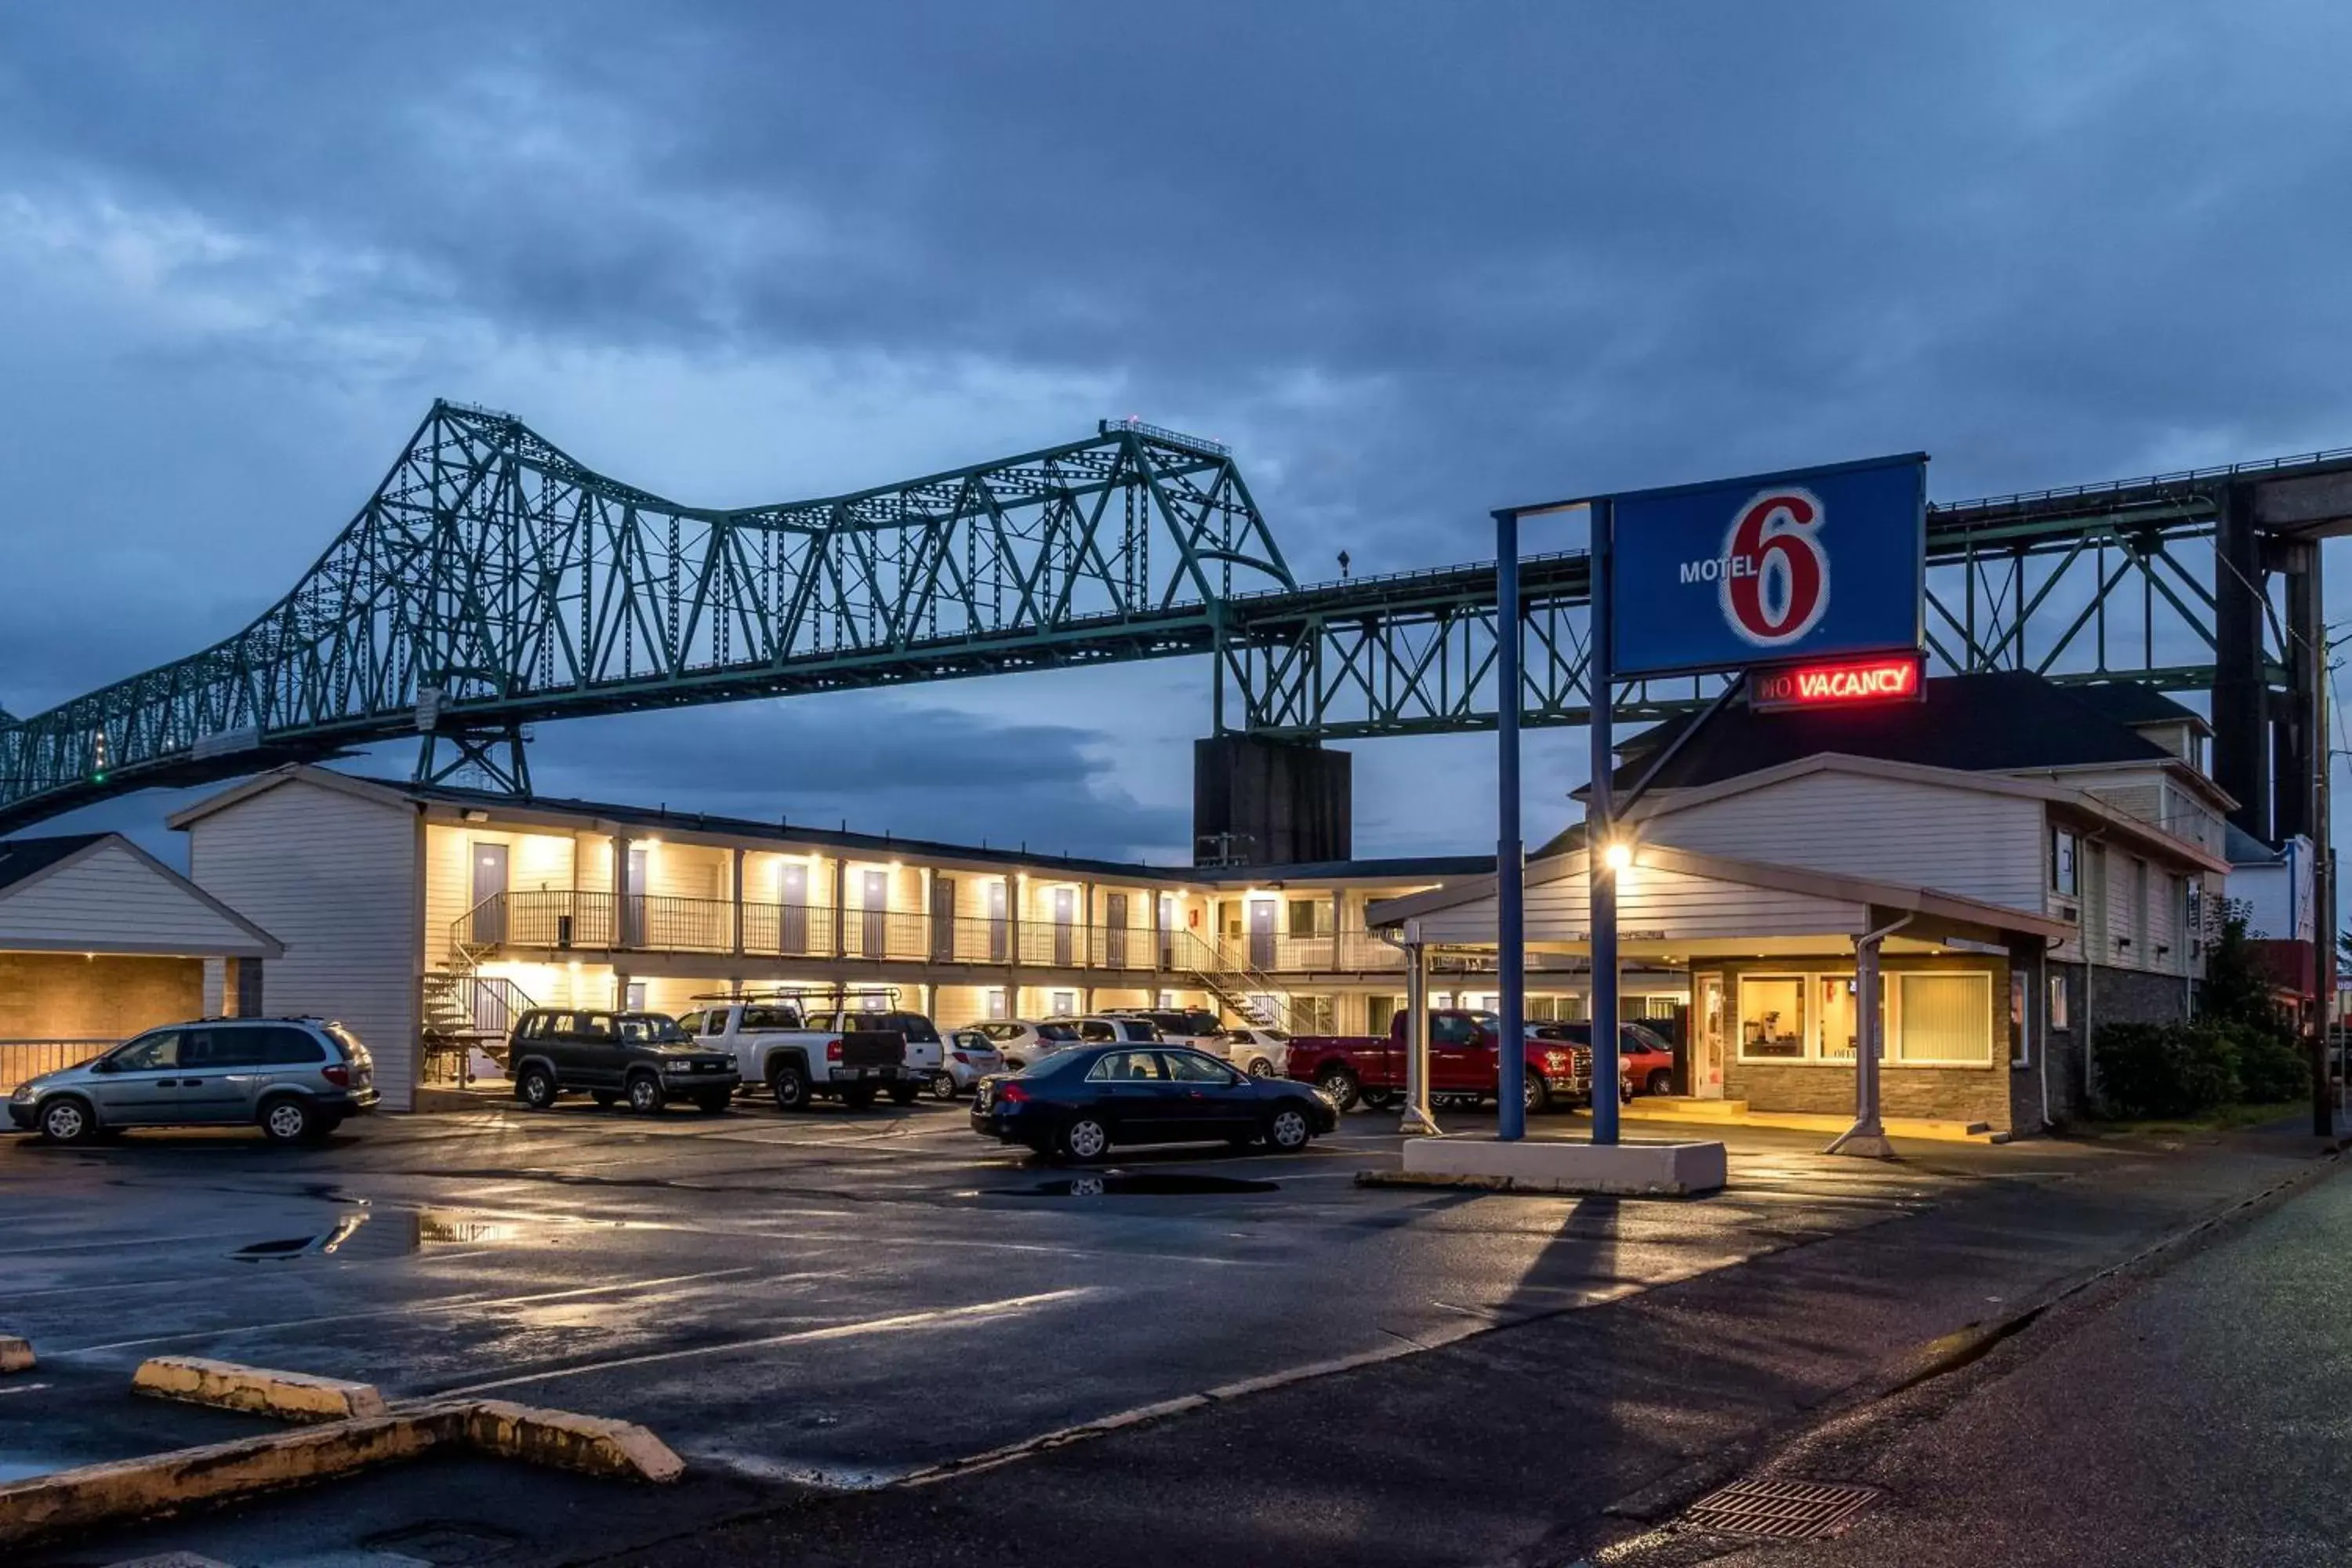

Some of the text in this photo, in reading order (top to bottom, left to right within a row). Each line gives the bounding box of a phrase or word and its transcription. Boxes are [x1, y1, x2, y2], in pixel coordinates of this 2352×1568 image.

[1680, 492, 1824, 642] MOTEL 6
[1761, 665, 1910, 698] NO VACANCY
